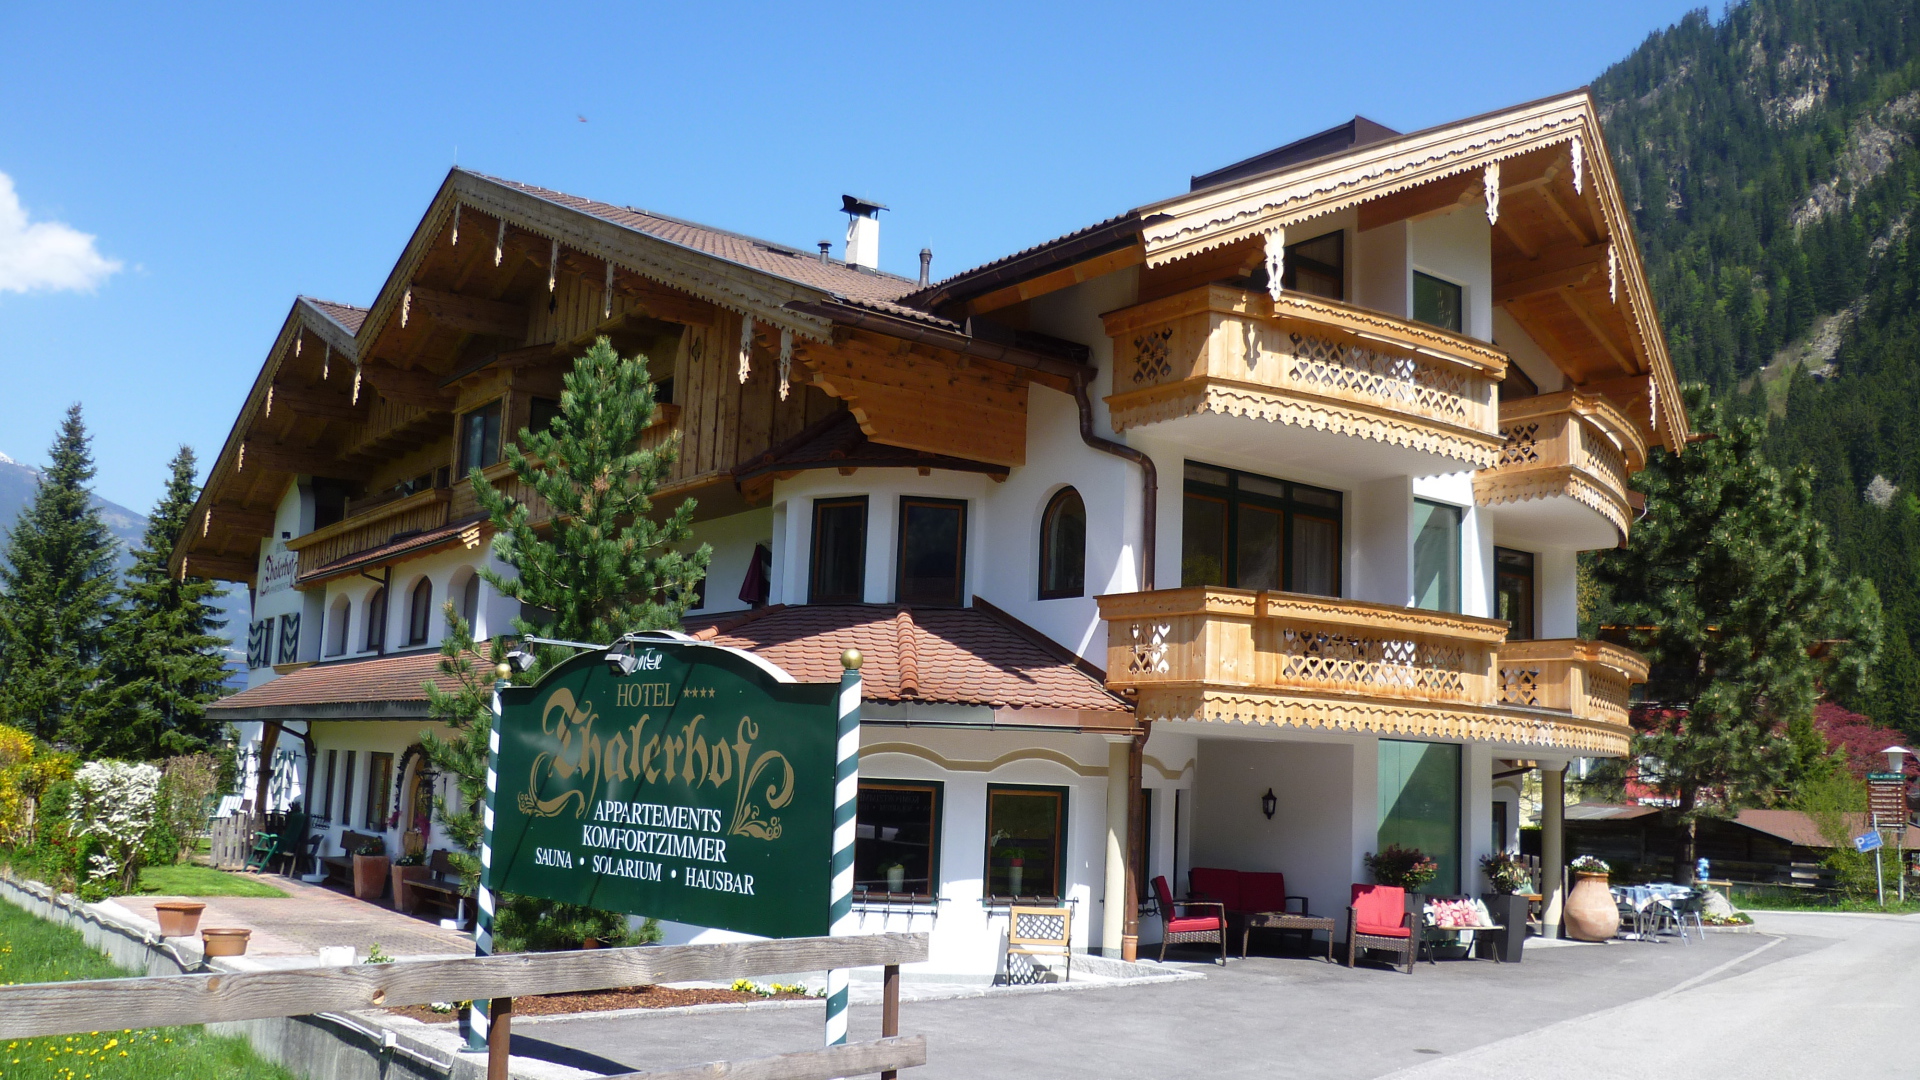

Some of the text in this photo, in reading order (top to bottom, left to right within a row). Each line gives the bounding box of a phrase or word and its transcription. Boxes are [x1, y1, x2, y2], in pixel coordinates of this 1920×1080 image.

[616, 683, 676, 707] HOTEL
[541, 687, 759, 820] Thalerhof
[593, 800, 722, 833] APPARTEMENTS
[582, 825, 727, 863] KOMFORTZIMMER
[535, 847, 755, 895] SAUNA SOLARIUM HAUSBAR
